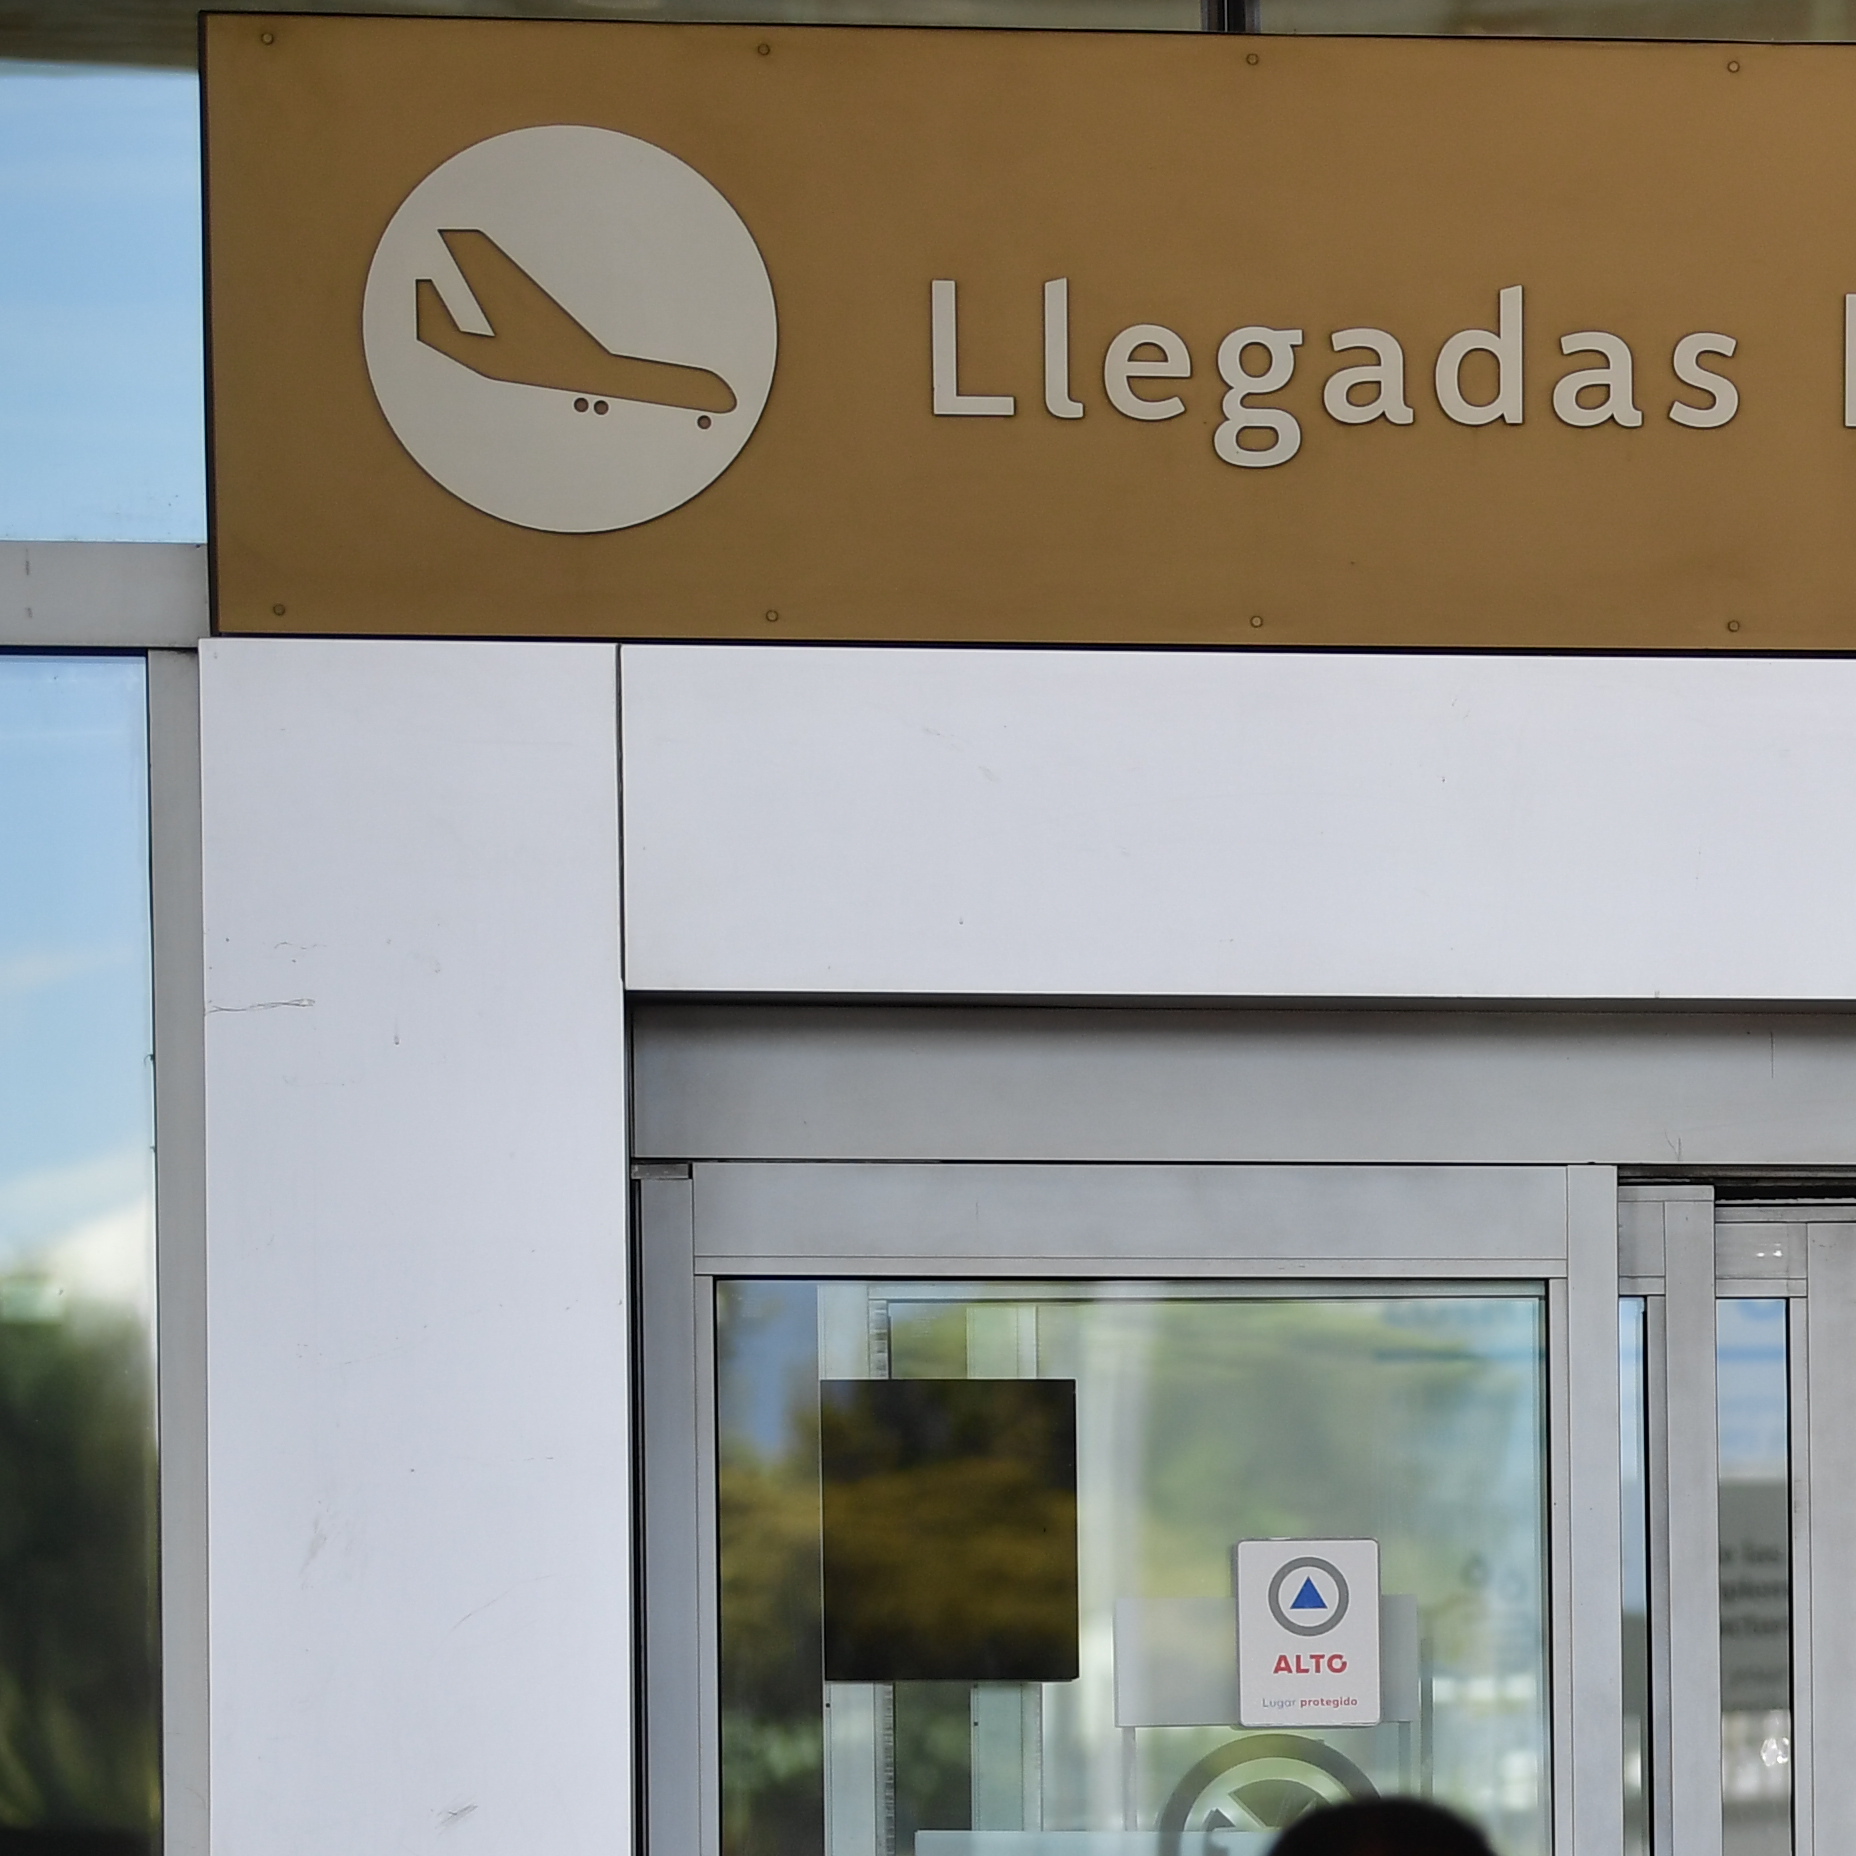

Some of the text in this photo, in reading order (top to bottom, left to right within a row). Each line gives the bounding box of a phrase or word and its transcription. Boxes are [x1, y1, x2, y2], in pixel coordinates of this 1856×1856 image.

[930, 277, 1740, 468] Llegadas
[1273, 1653, 1348, 1674] ALTO
[1262, 1697, 1358, 1710] Lugar protegido
